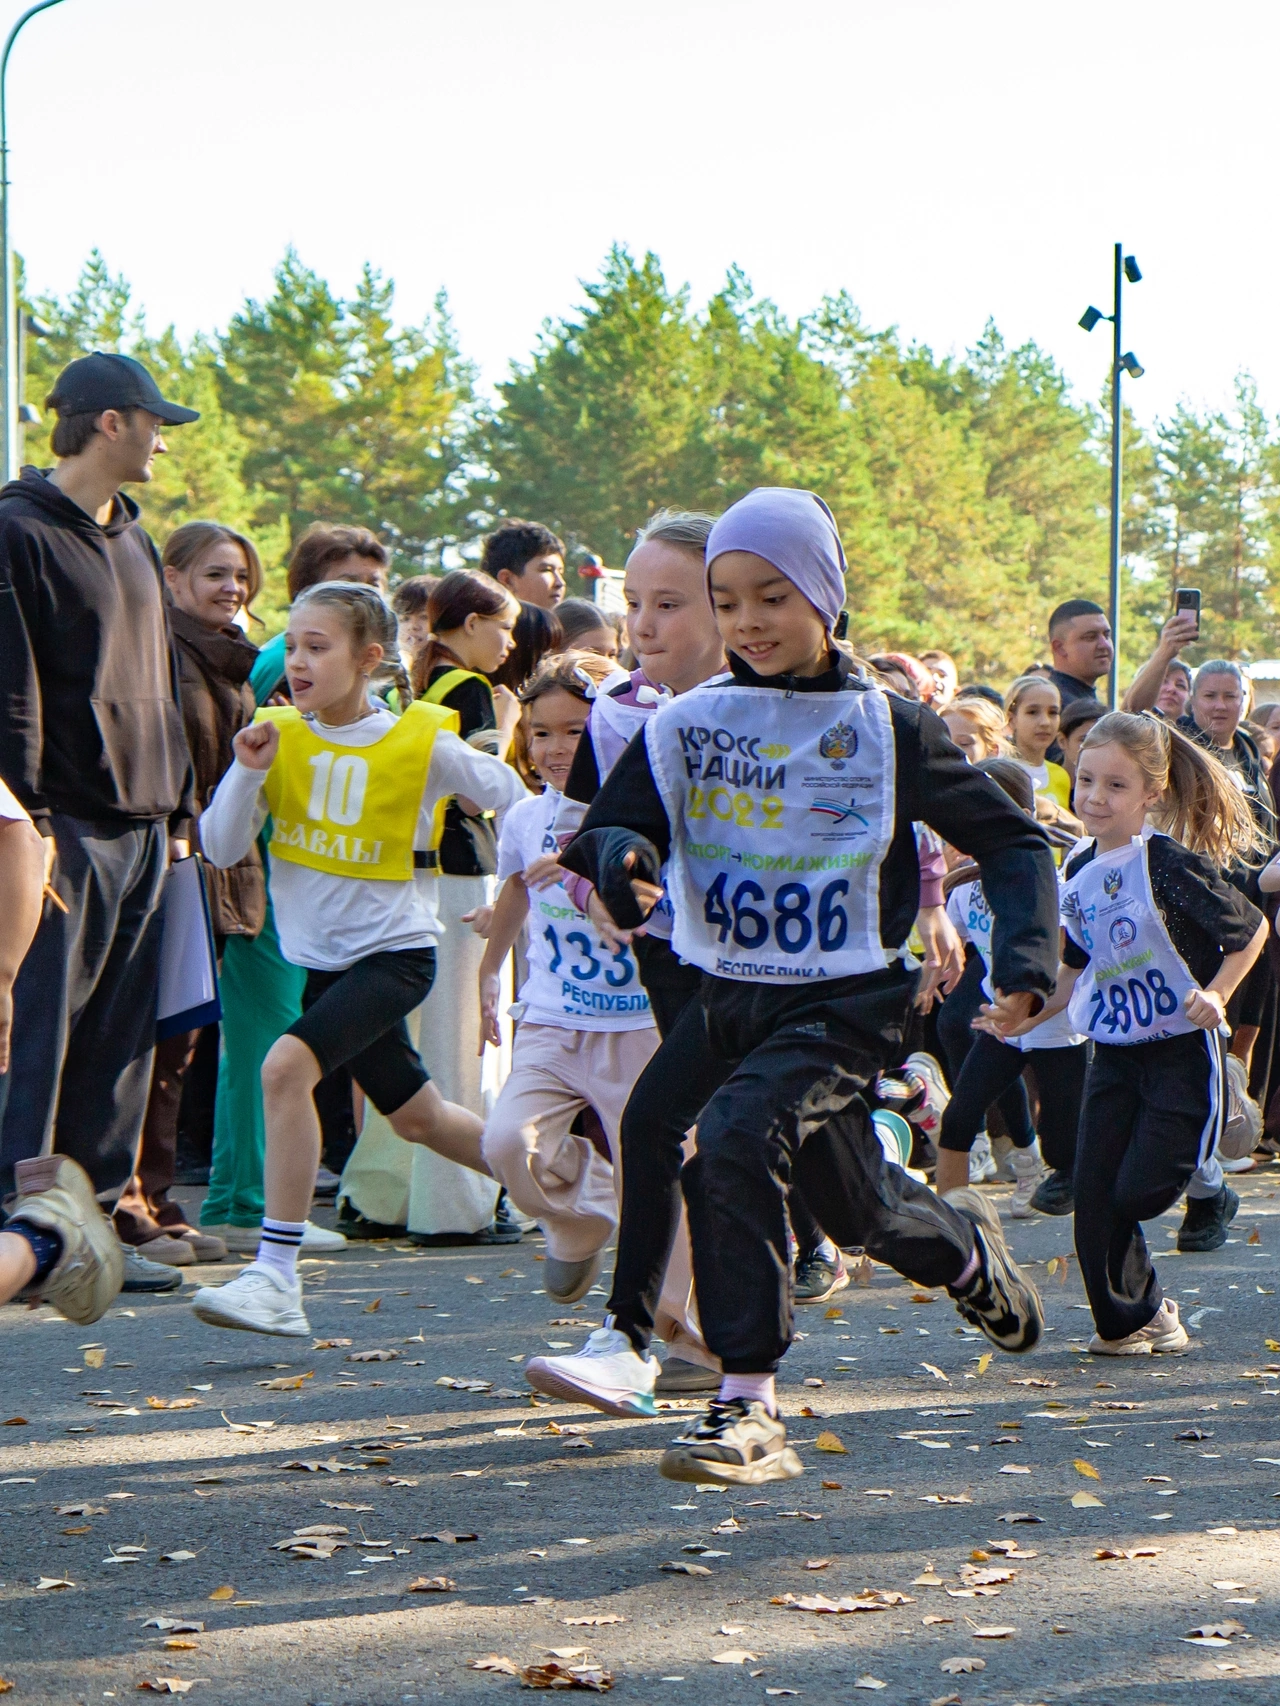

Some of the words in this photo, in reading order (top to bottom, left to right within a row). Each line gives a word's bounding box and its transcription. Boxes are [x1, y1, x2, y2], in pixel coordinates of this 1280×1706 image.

[677, 726, 761, 762] КРОСС
[307, 750, 369, 826] 10
[684, 755, 786, 789] НАЦИИ
[686, 785, 784, 829] 2022
[273, 817, 384, 865] БАВЛЫ
[741, 852, 805, 873] НОРМА
[808, 852, 874, 872] ЖИЗНИ
[704, 871, 850, 954] 4686
